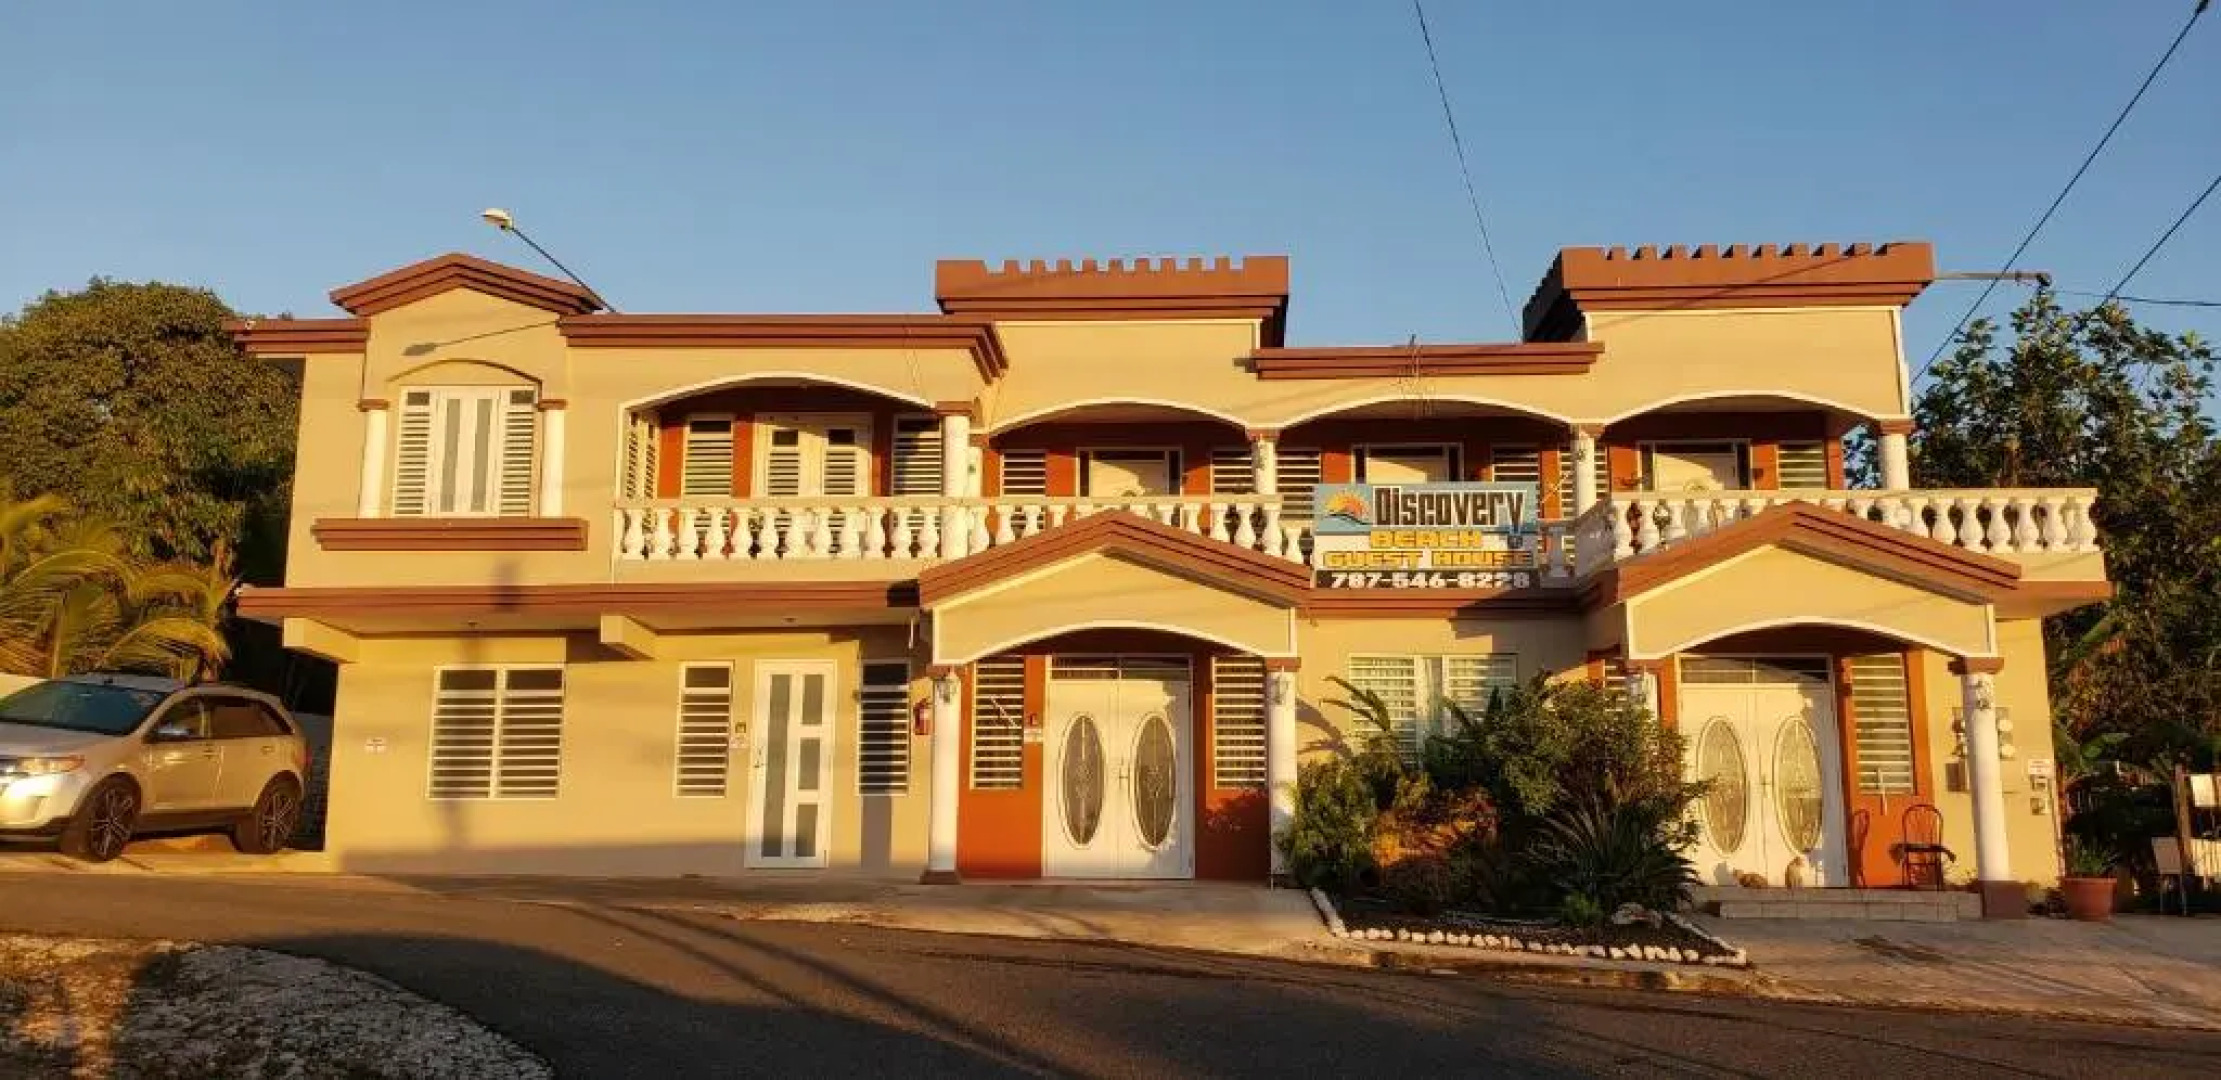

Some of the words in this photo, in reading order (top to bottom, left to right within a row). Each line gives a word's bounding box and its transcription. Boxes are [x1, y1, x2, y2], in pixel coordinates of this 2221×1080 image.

[1371, 532, 1482, 548] BEACH
[1324, 551, 1423, 567] GUEST
[1431, 551, 1533, 567] HOUSE
[1331, 572, 1530, 588] 787-546-8228
